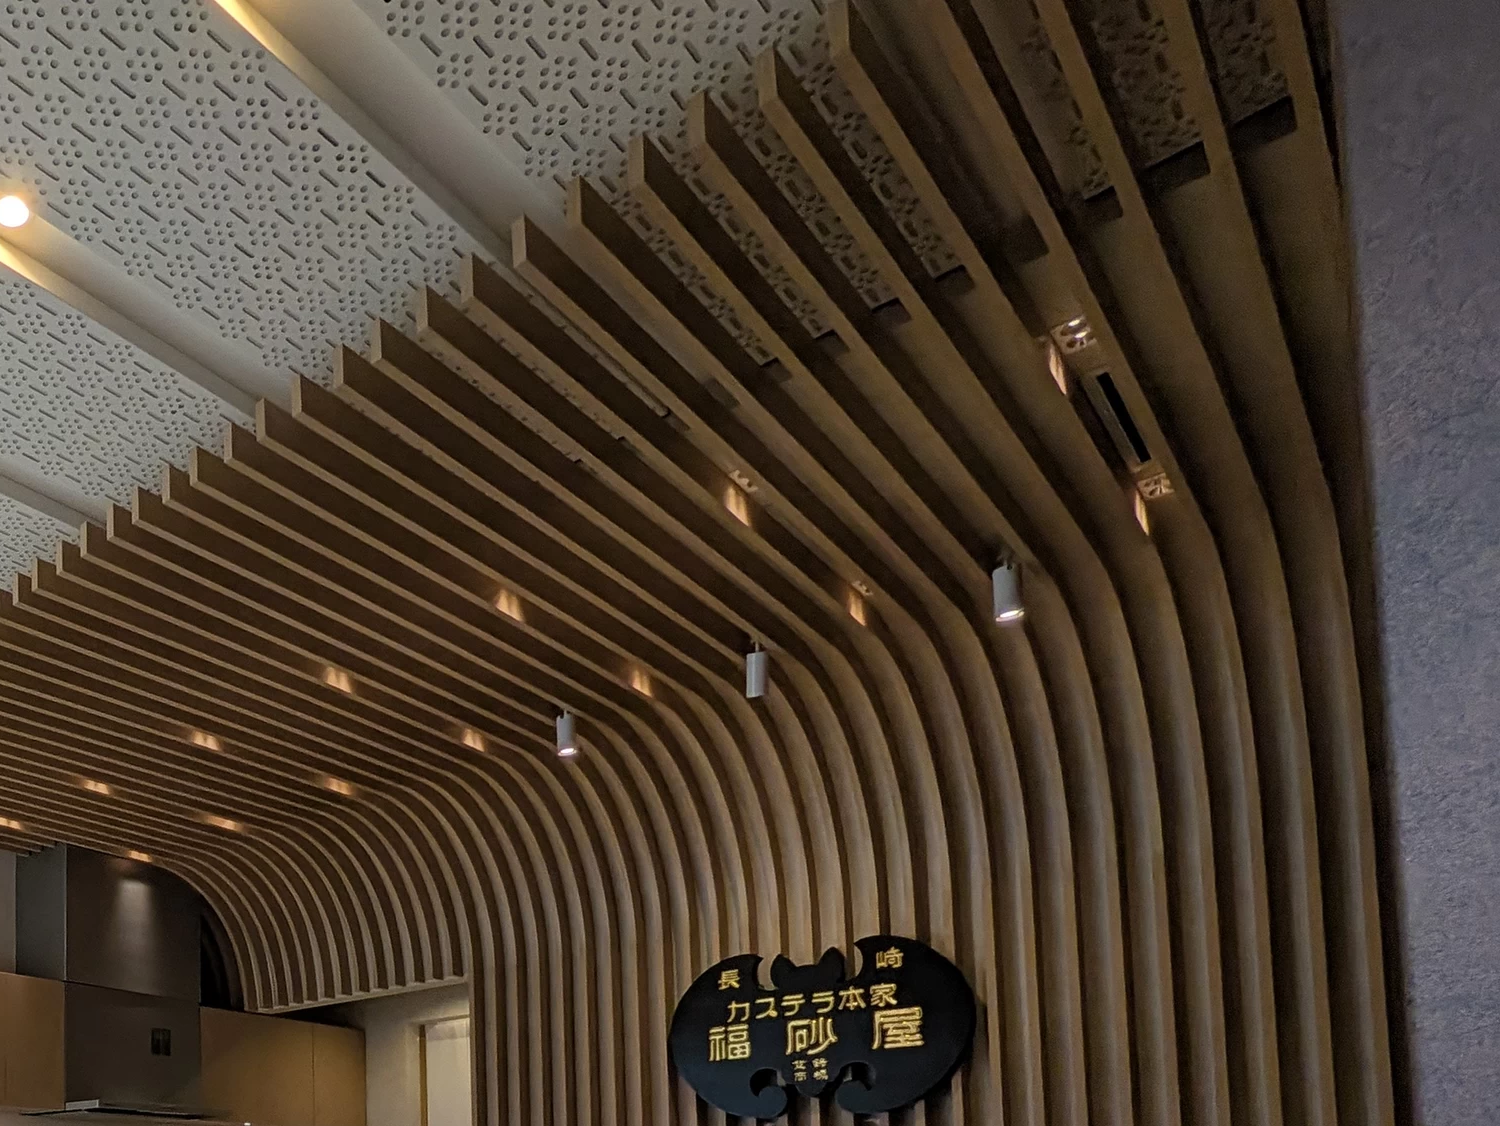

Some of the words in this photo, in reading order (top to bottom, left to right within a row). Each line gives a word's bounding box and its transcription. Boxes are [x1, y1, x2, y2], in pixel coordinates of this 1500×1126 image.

[717, 968, 742, 991] 長
[726, 982, 898, 1023] カステラ本家
[707, 1006, 925, 1062] 福砂屋
